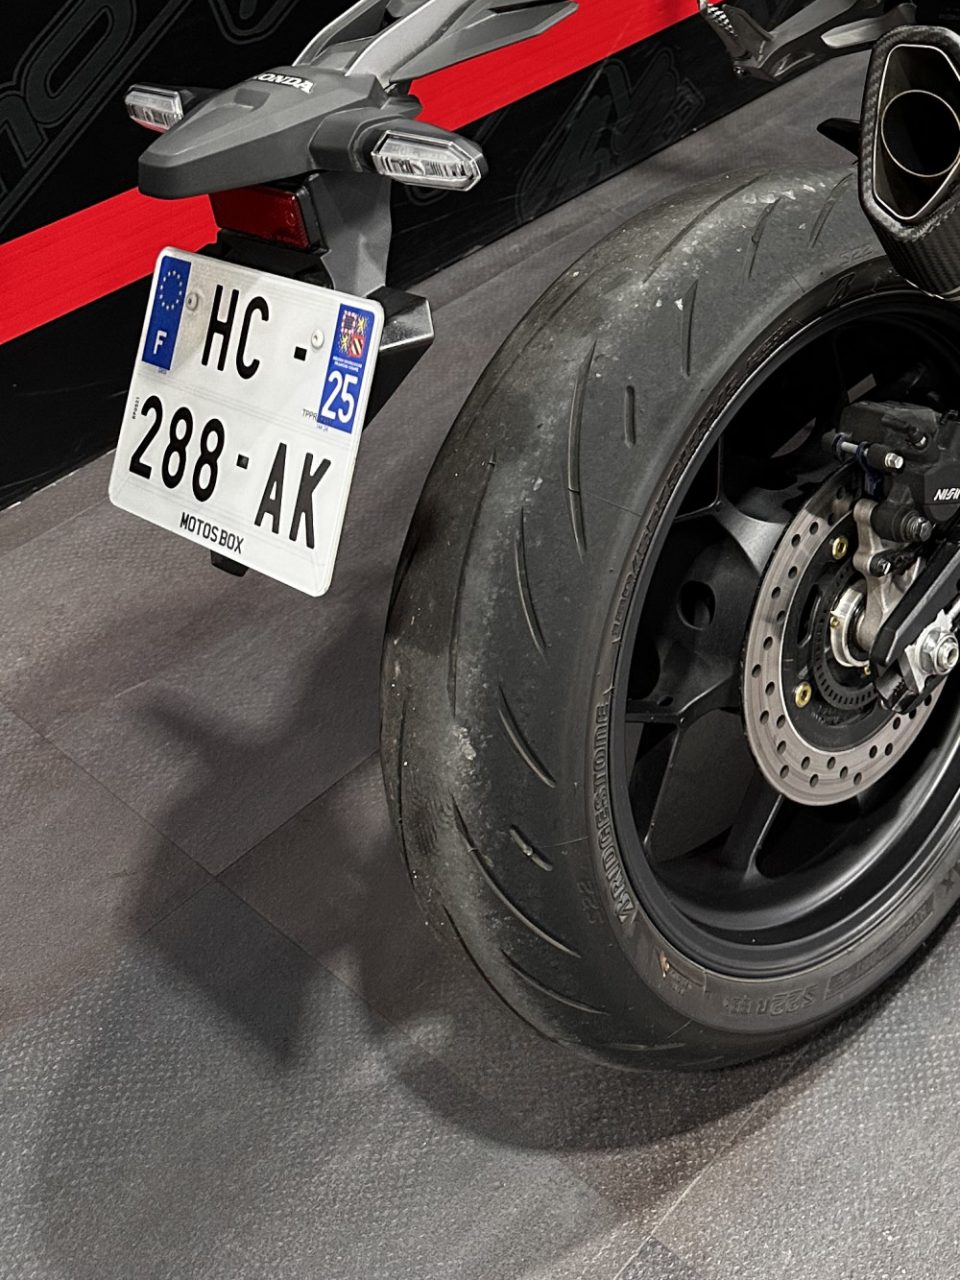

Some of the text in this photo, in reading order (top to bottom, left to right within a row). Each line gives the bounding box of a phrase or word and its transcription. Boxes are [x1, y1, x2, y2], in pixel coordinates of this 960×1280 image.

[153, 329, 168, 355] F
[201, 284, 270, 380] HC
[322, 370, 356, 423] 25
[591, 703, 635, 923] BRIDGESTONE
